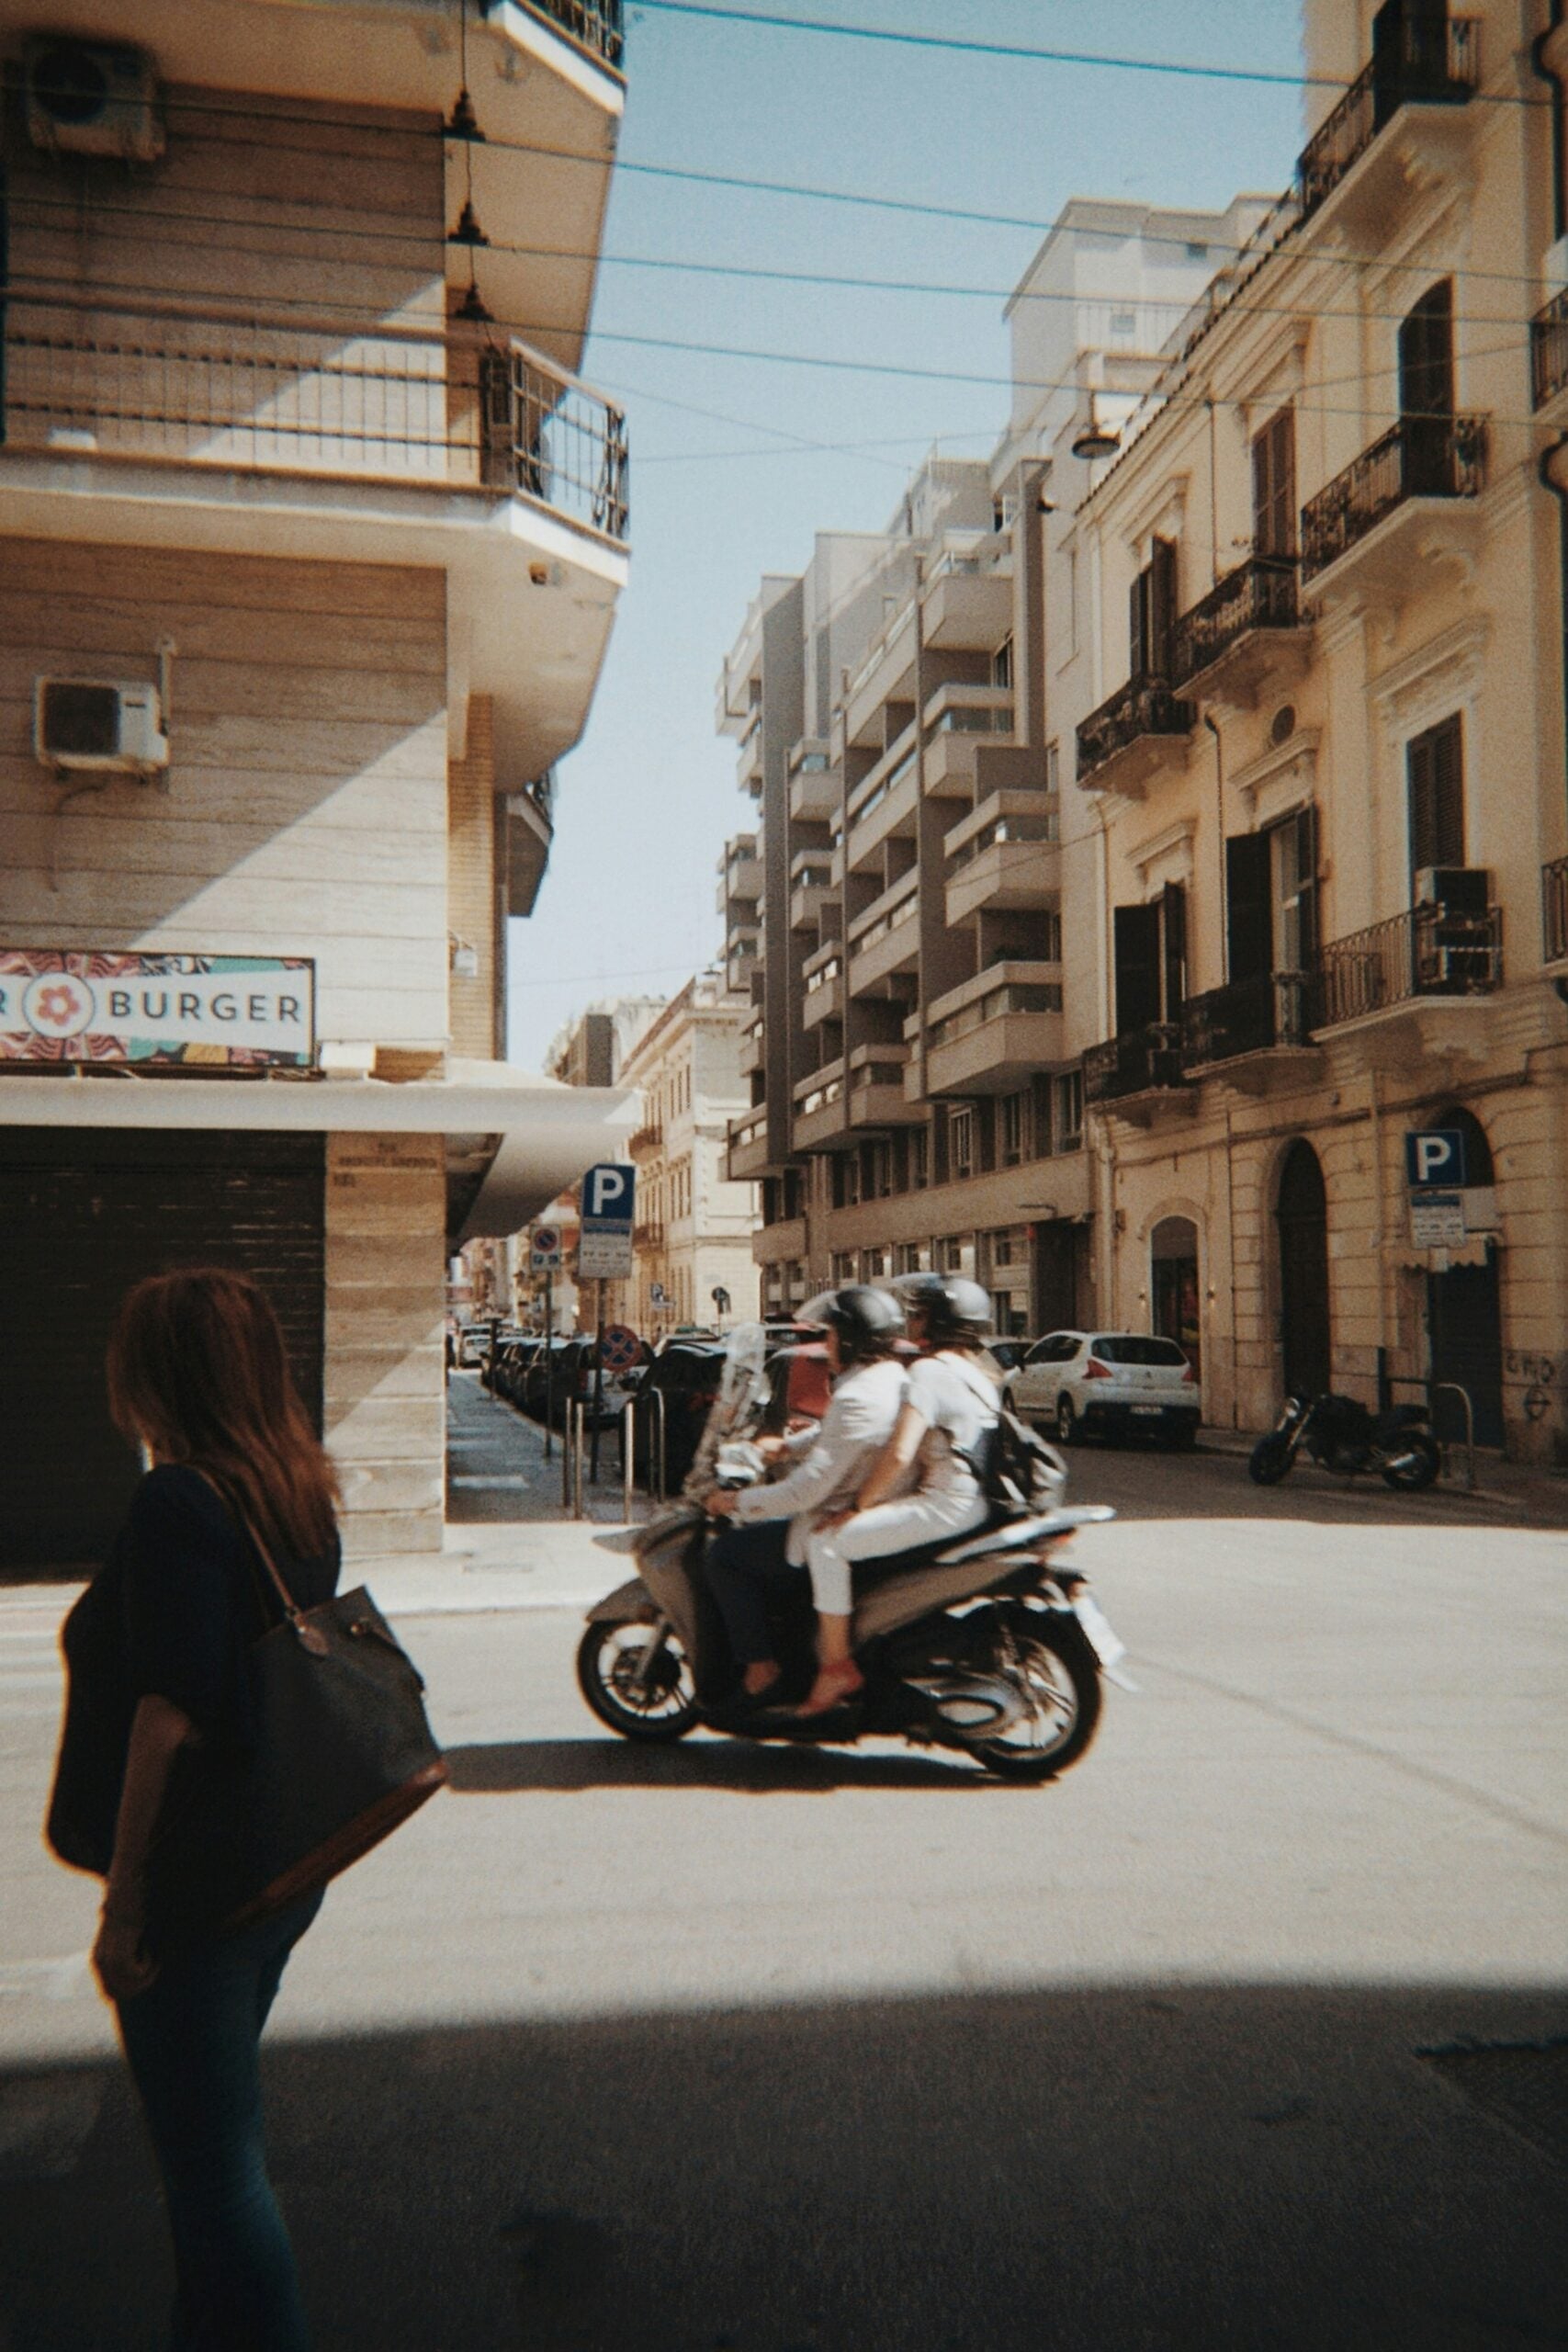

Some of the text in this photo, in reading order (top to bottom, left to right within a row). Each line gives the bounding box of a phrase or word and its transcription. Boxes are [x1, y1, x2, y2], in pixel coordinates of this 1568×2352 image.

[109, 990, 299, 1023] BURGER
[1416, 1136, 1451, 1182] P
[592, 1169, 625, 1215] P
